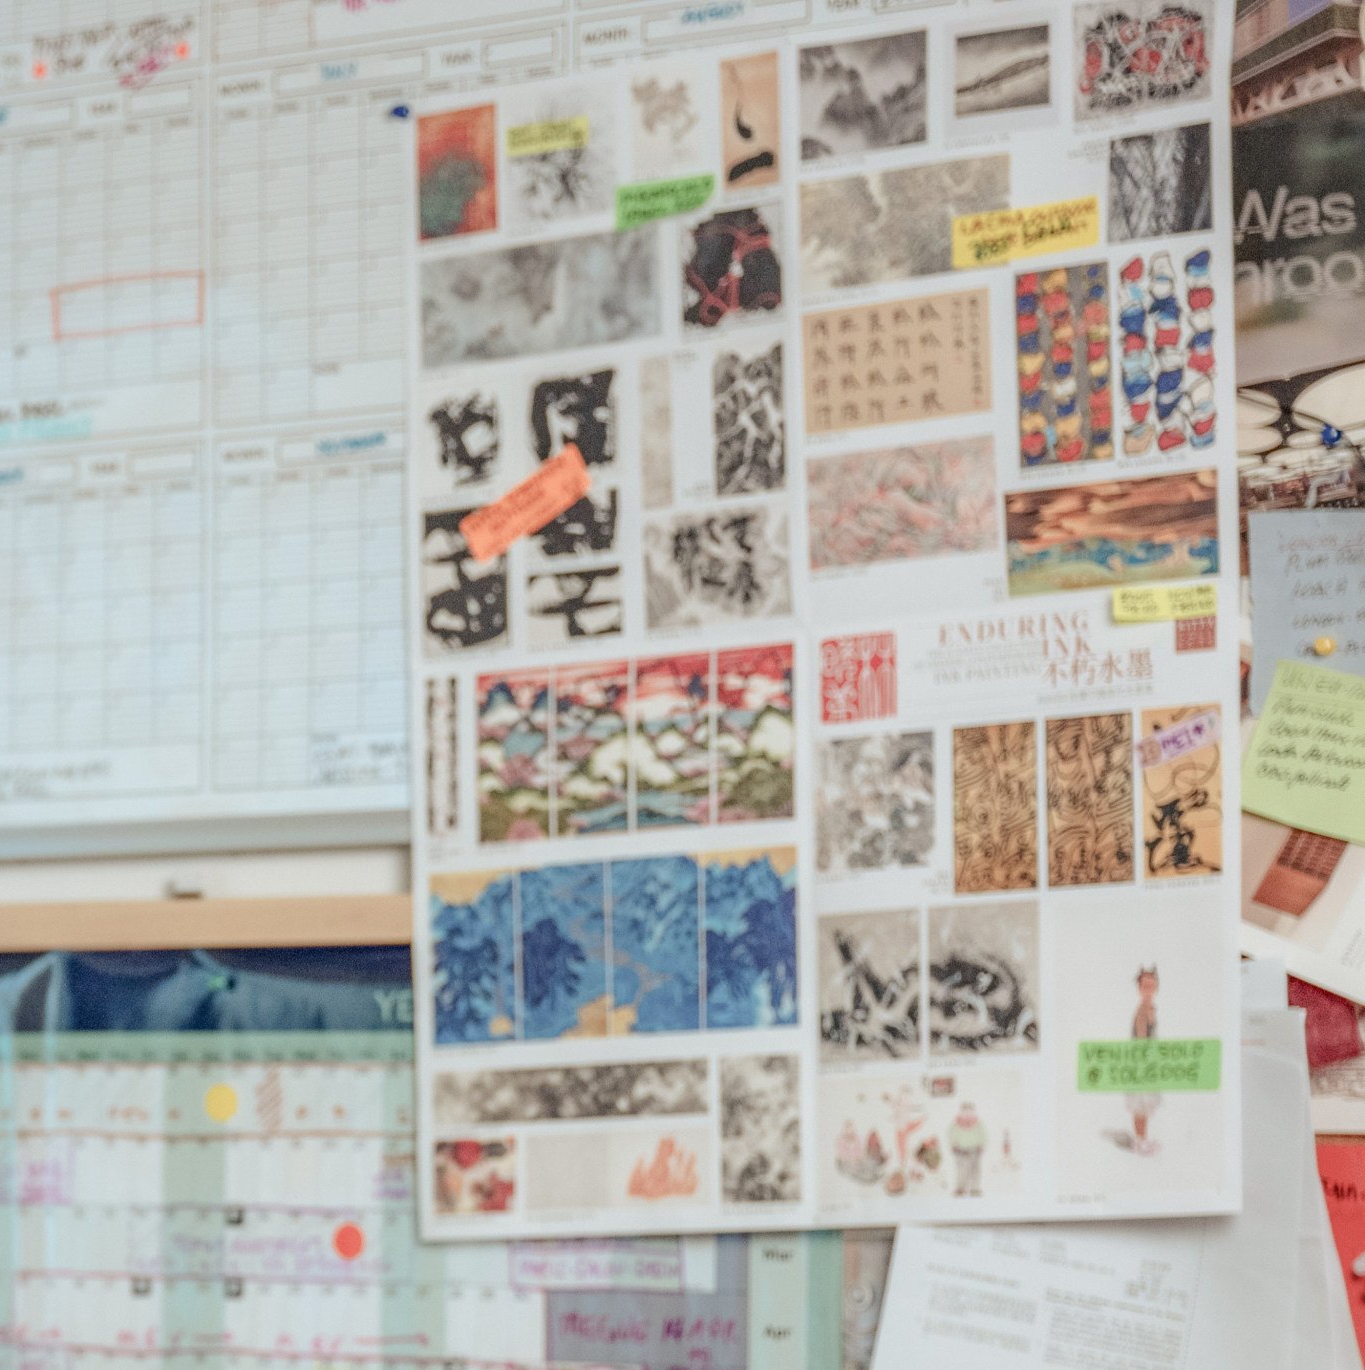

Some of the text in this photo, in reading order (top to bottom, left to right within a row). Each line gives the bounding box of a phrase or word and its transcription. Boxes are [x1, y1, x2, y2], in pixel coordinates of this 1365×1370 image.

[937, 609, 1091, 647] ENDURING
[1040, 631, 1092, 658] INK
[373, 989, 412, 1024] YE
